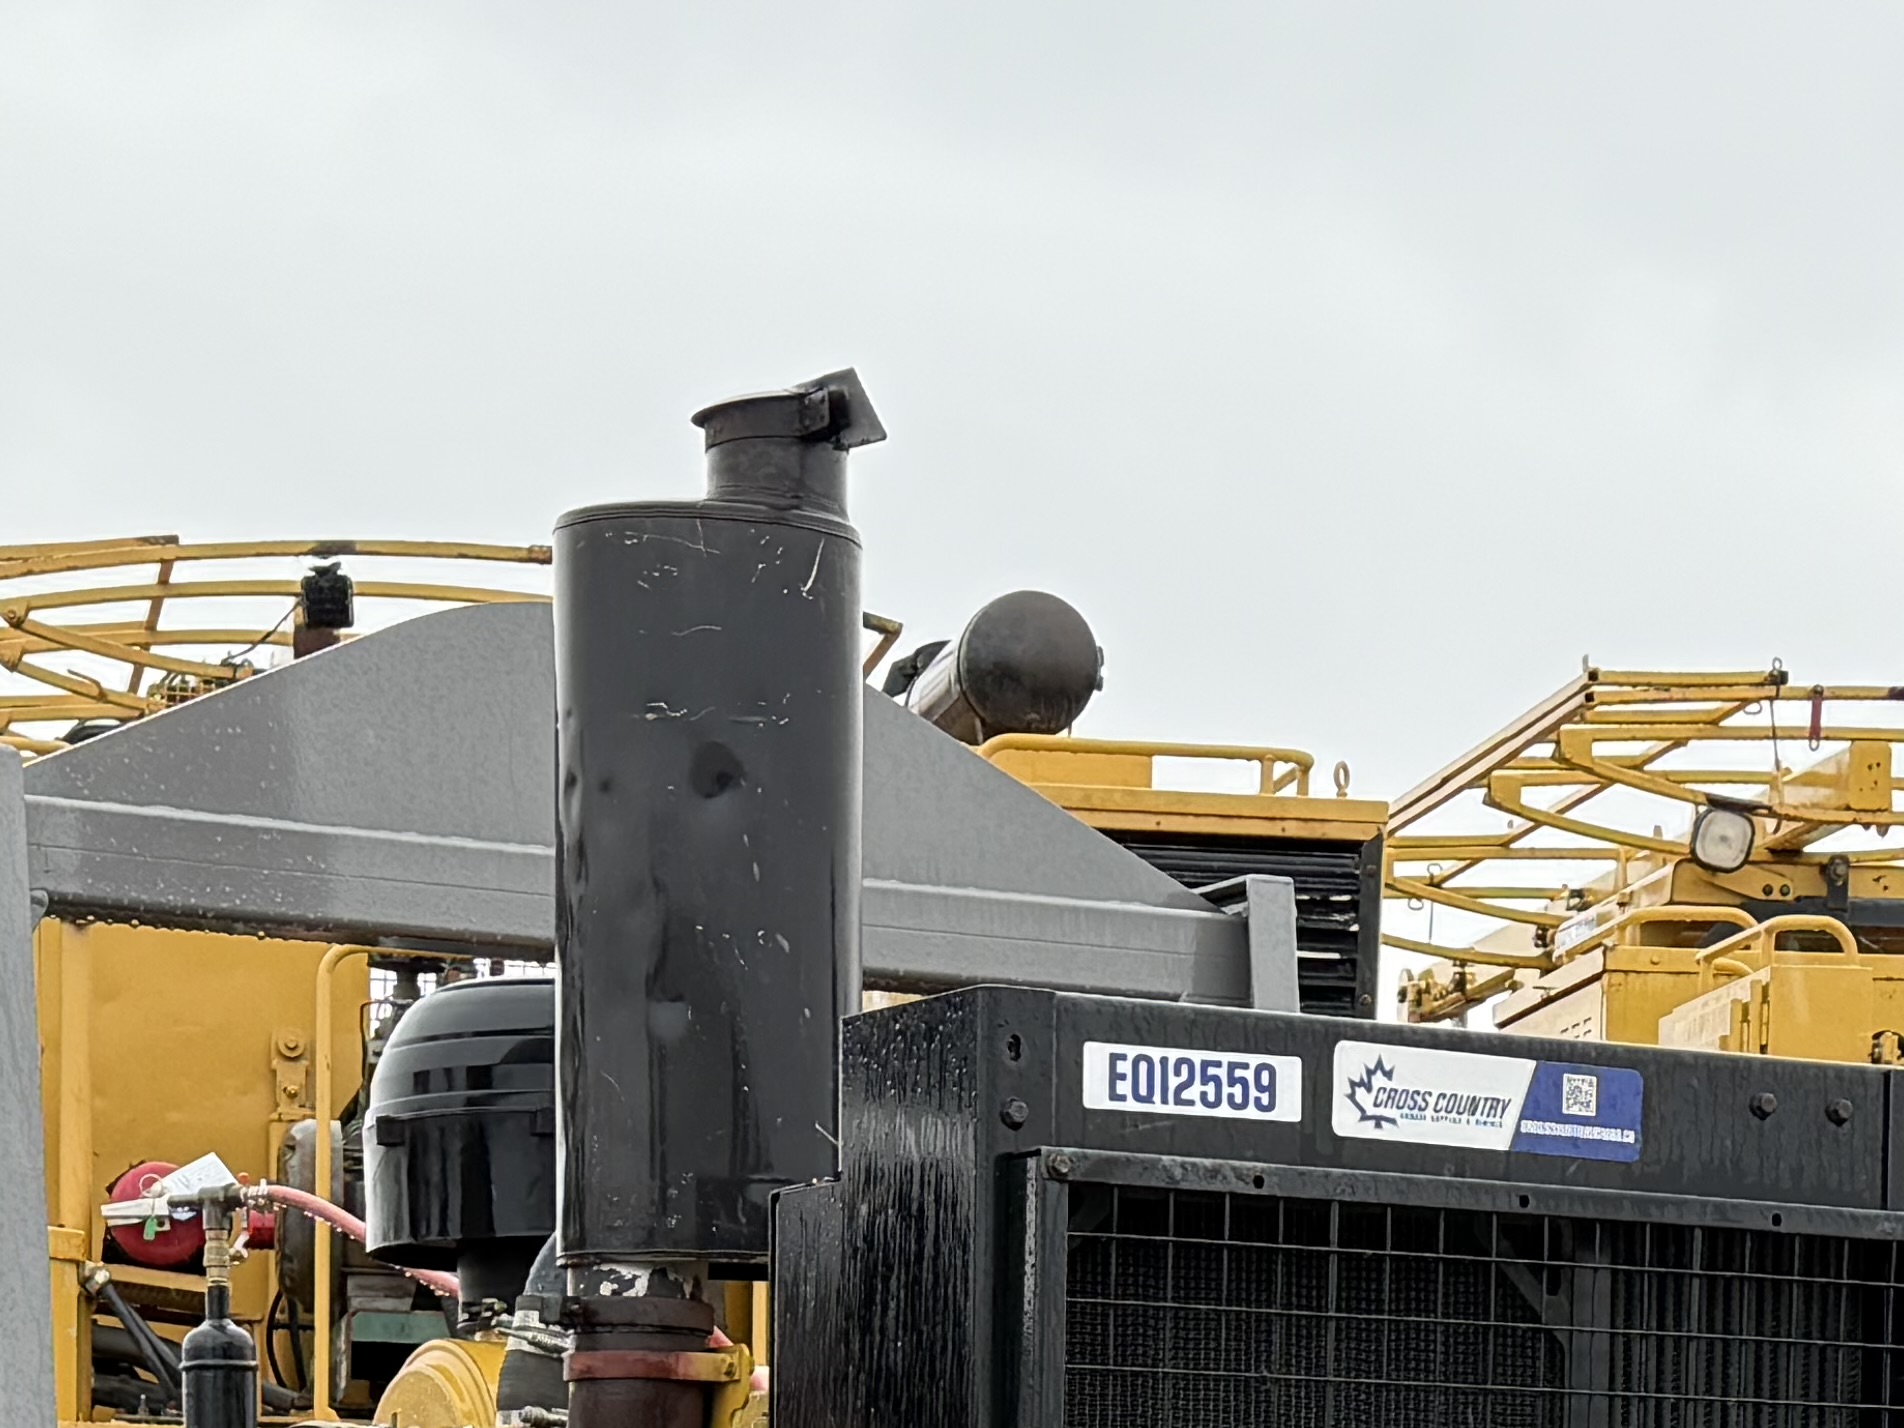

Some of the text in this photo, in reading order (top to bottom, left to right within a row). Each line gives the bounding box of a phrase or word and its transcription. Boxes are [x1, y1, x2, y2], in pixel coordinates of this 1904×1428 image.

[1108, 1052, 1277, 1113] EQ12559
[1373, 1086, 1512, 1119] CROSS COUNTRY
